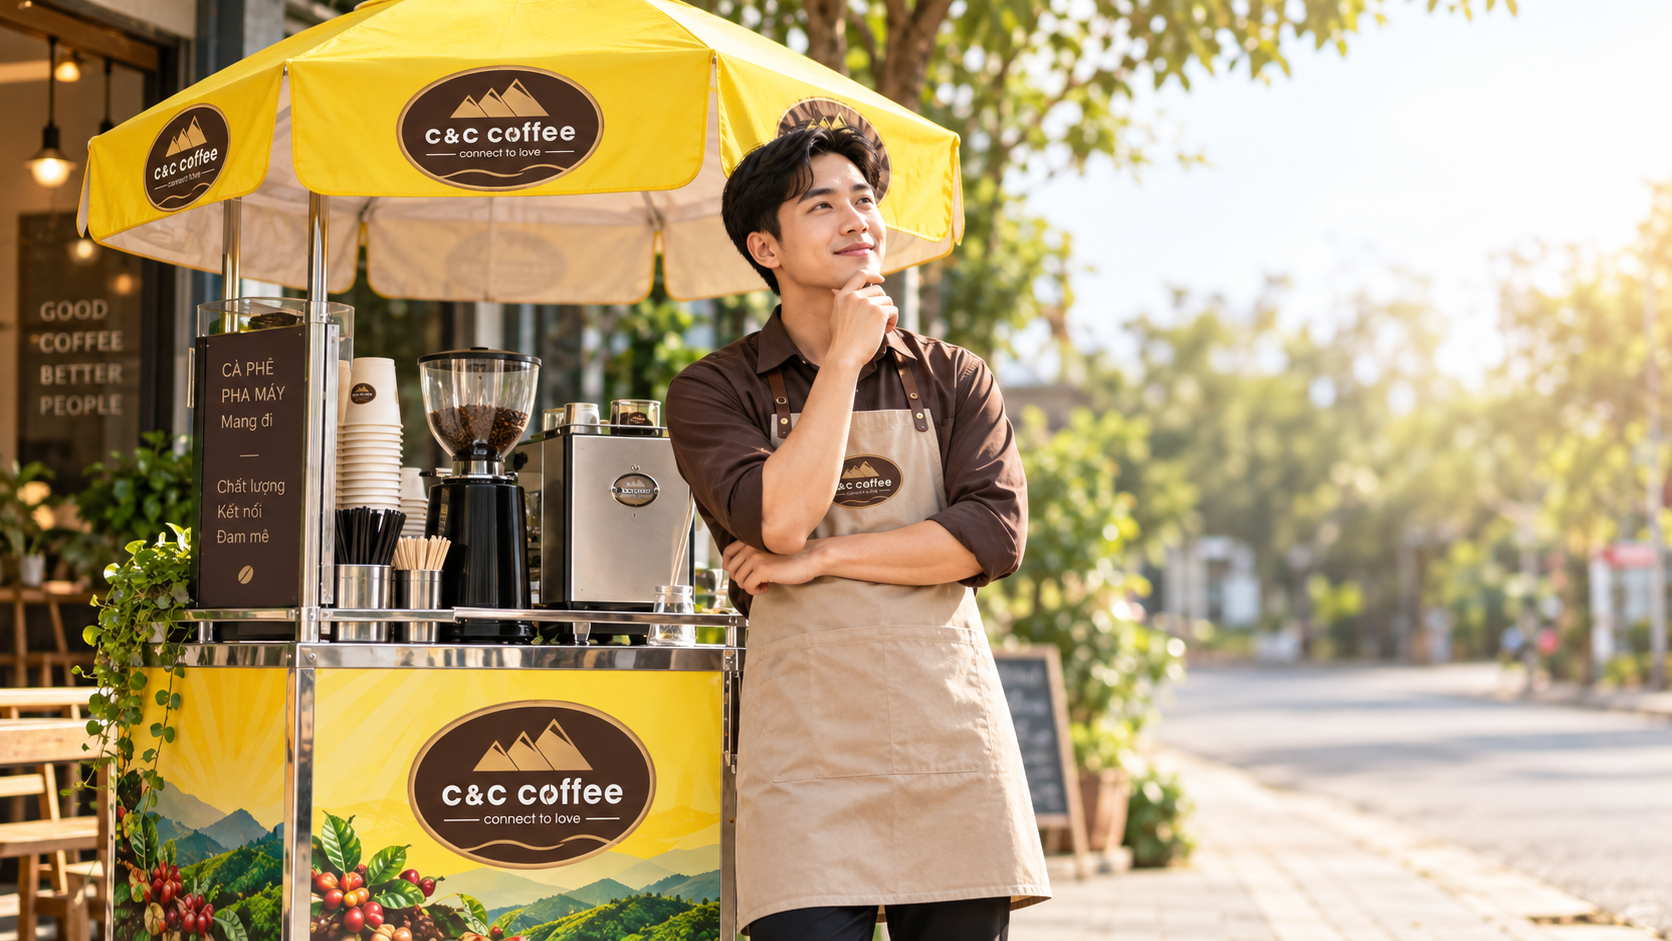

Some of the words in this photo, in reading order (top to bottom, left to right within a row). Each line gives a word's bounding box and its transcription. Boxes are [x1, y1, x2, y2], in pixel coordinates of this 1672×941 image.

[425, 127, 479, 144] c&c
[487, 121, 576, 143] coffee
[459, 149, 503, 158] connect
[505, 149, 516, 157] to
[518, 148, 541, 157] love
[154, 162, 177, 180] c&c
[179, 148, 218, 171] coffee
[40, 299, 108, 322] GOOD
[40, 330, 123, 353] COFFEE
[40, 363, 123, 385] BETTER
[222, 359, 242, 377] CÀ
[246, 357, 274, 376] PHÊ
[222, 388, 251, 403] PHA
[255, 383, 285, 401] MÁY
[40, 394, 123, 416] PEOPLE
[221, 415, 257, 431] Mang
[261, 413, 273, 427] đi
[217, 478, 247, 493] Chất
[250, 479, 285, 495] lượng
[855, 478, 892, 488] coffee
[217, 503, 239, 518] Kết
[243, 502, 262, 518] nối
[217, 529, 246, 543] Đam
[250, 529, 269, 543] mê
[442, 785, 507, 806] c&c
[517, 777, 623, 805] coffee
[484, 814, 536, 825] connect
[539, 814, 552, 824] to
[555, 813, 581, 824] love
